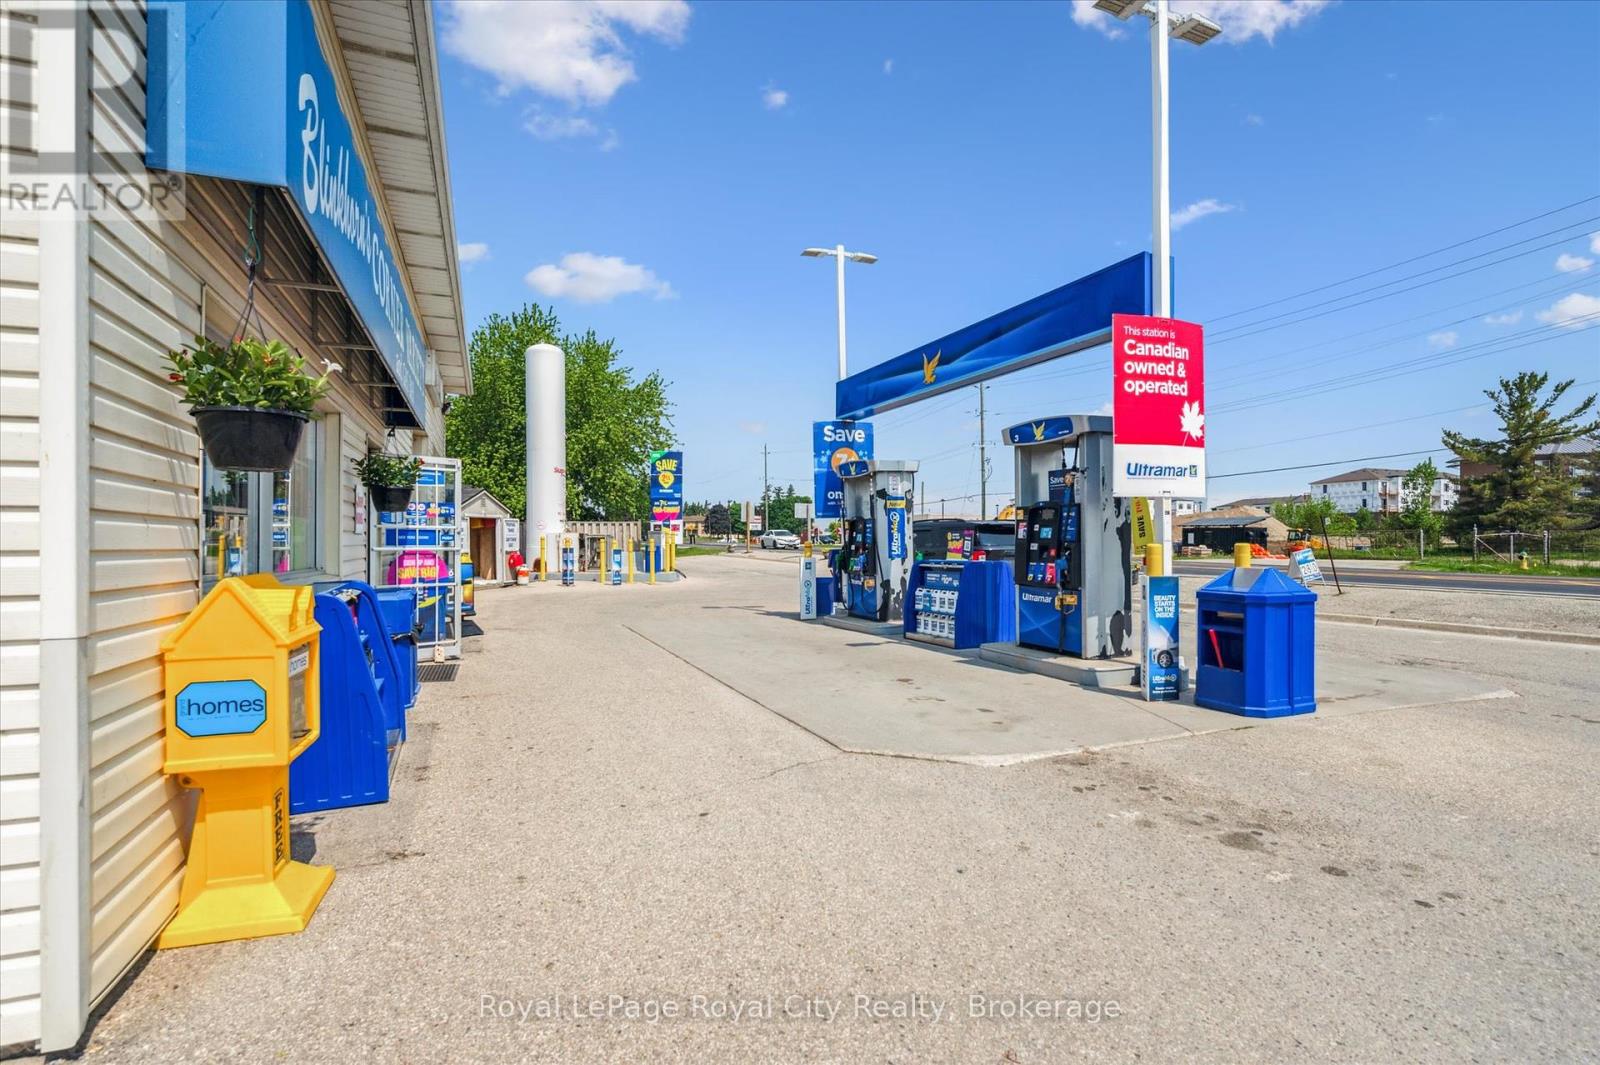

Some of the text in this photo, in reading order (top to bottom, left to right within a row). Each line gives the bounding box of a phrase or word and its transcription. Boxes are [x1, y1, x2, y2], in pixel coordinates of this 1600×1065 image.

[1123, 325, 1176, 339] This station is
[1123, 339, 1190, 361] Canadian
[1123, 360, 1187, 378] owned &
[1123, 379, 1188, 397] operated
[823, 425, 866, 443] Save
[1014, 434, 1020, 442] 3
[655, 459, 678, 471] SAVE
[1126, 462, 1188, 478] Ultramar
[1049, 476, 1064, 485] Save
[1137, 515, 1146, 538] SAVE
[1022, 592, 1053, 604] Ultramar
[187, 698, 264, 716] homes
[274, 790, 282, 861] FREE
